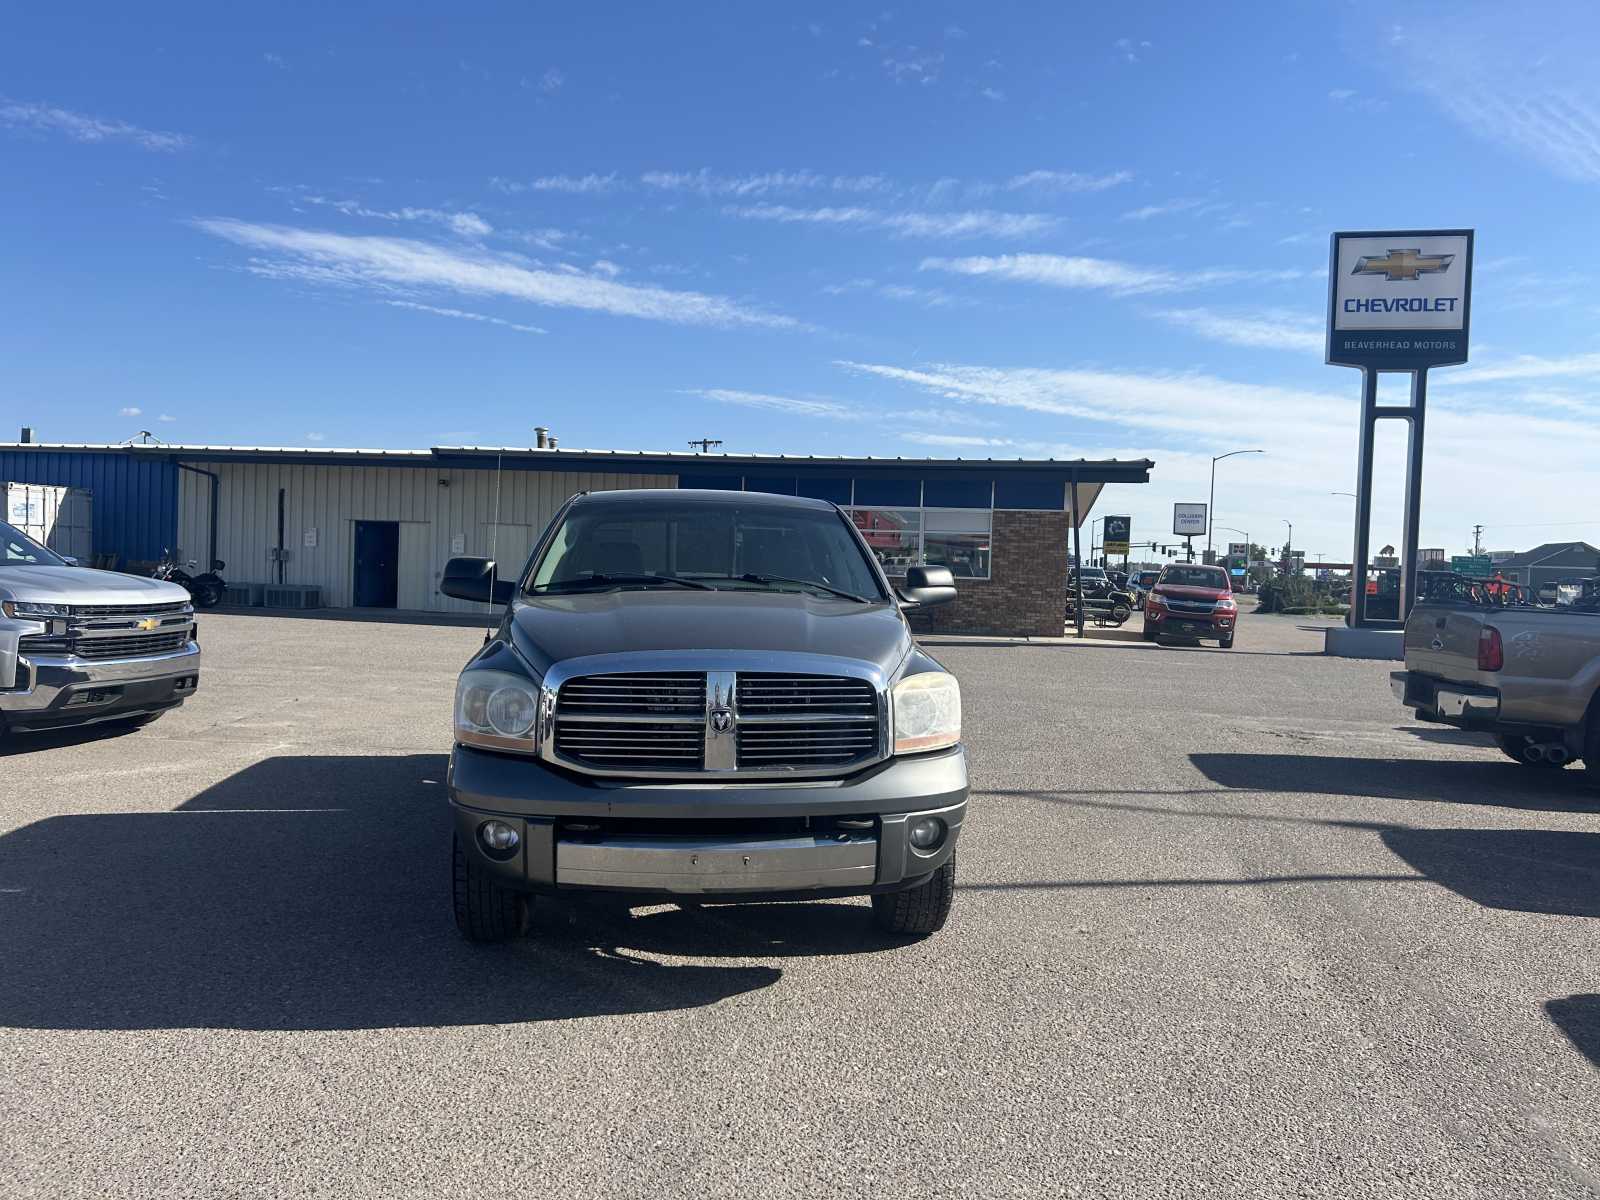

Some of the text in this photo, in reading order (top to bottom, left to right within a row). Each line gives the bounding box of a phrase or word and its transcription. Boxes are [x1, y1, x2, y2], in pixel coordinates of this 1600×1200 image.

[1344, 298, 1458, 312] CHEVROLET
[1344, 340, 1456, 350] BEAVERHEAD MOTORS
